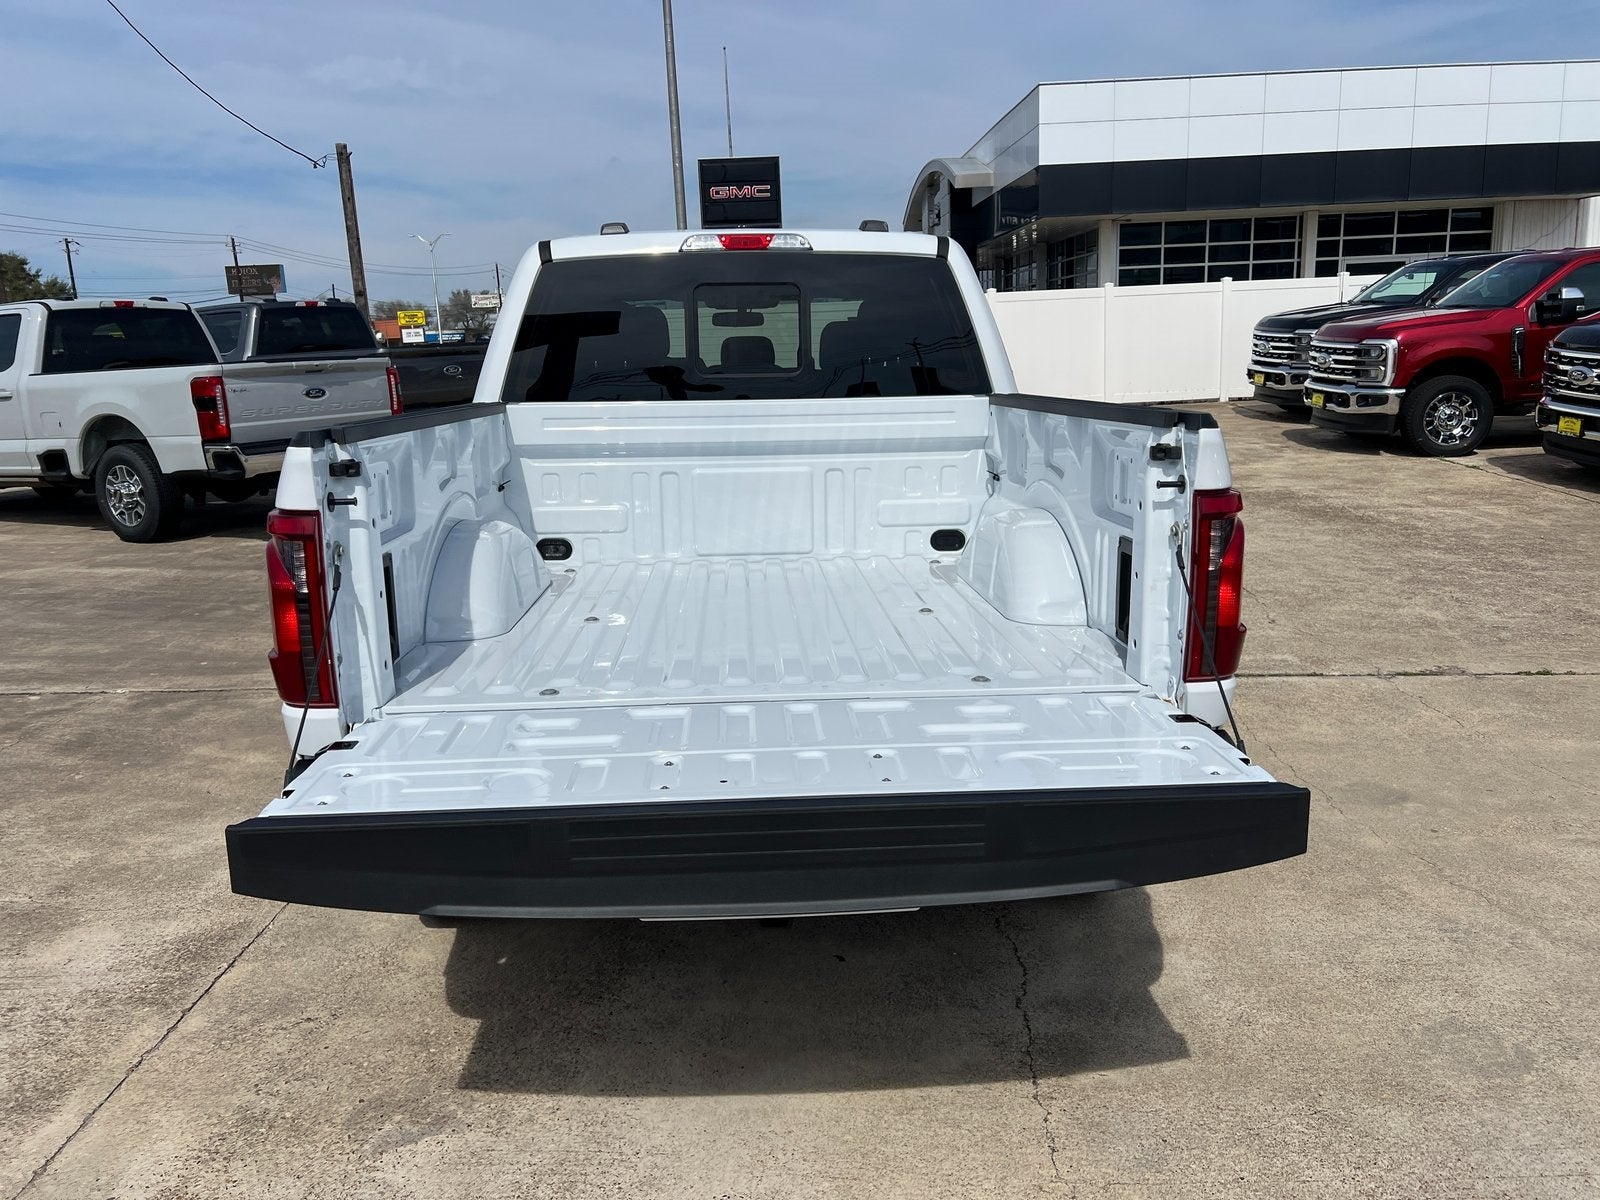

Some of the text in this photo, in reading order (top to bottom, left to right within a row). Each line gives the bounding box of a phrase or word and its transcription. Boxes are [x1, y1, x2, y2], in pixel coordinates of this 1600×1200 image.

[710, 185, 771, 199] GMC
[307, 388, 324, 398] Ford
[241, 400, 385, 418] SUPER DUTY
